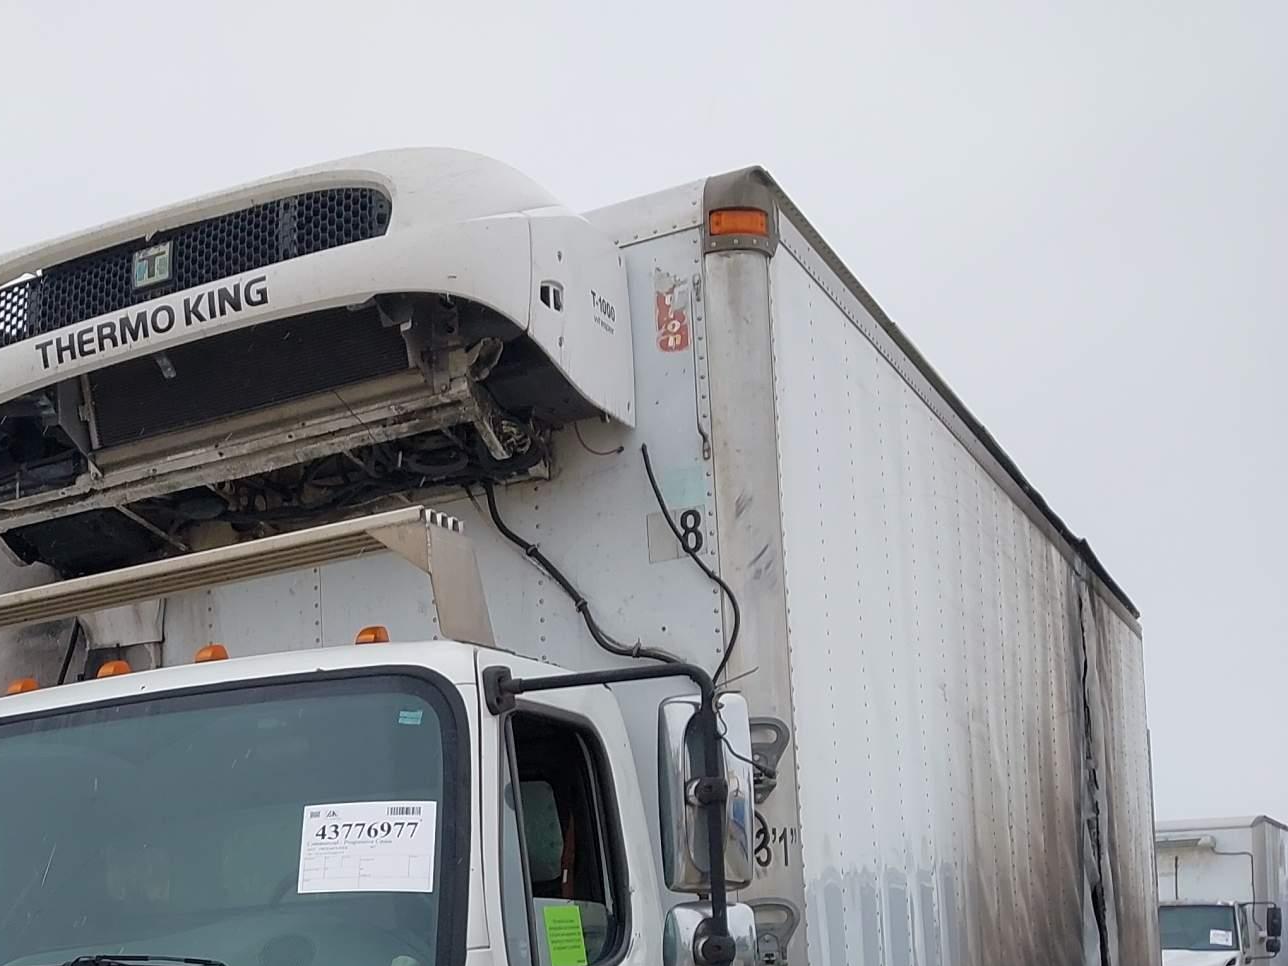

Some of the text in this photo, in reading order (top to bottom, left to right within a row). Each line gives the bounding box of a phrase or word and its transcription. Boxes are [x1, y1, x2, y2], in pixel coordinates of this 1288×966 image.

[35, 275, 269, 369] THERMO KING
[315, 821, 419, 840] 43776977
